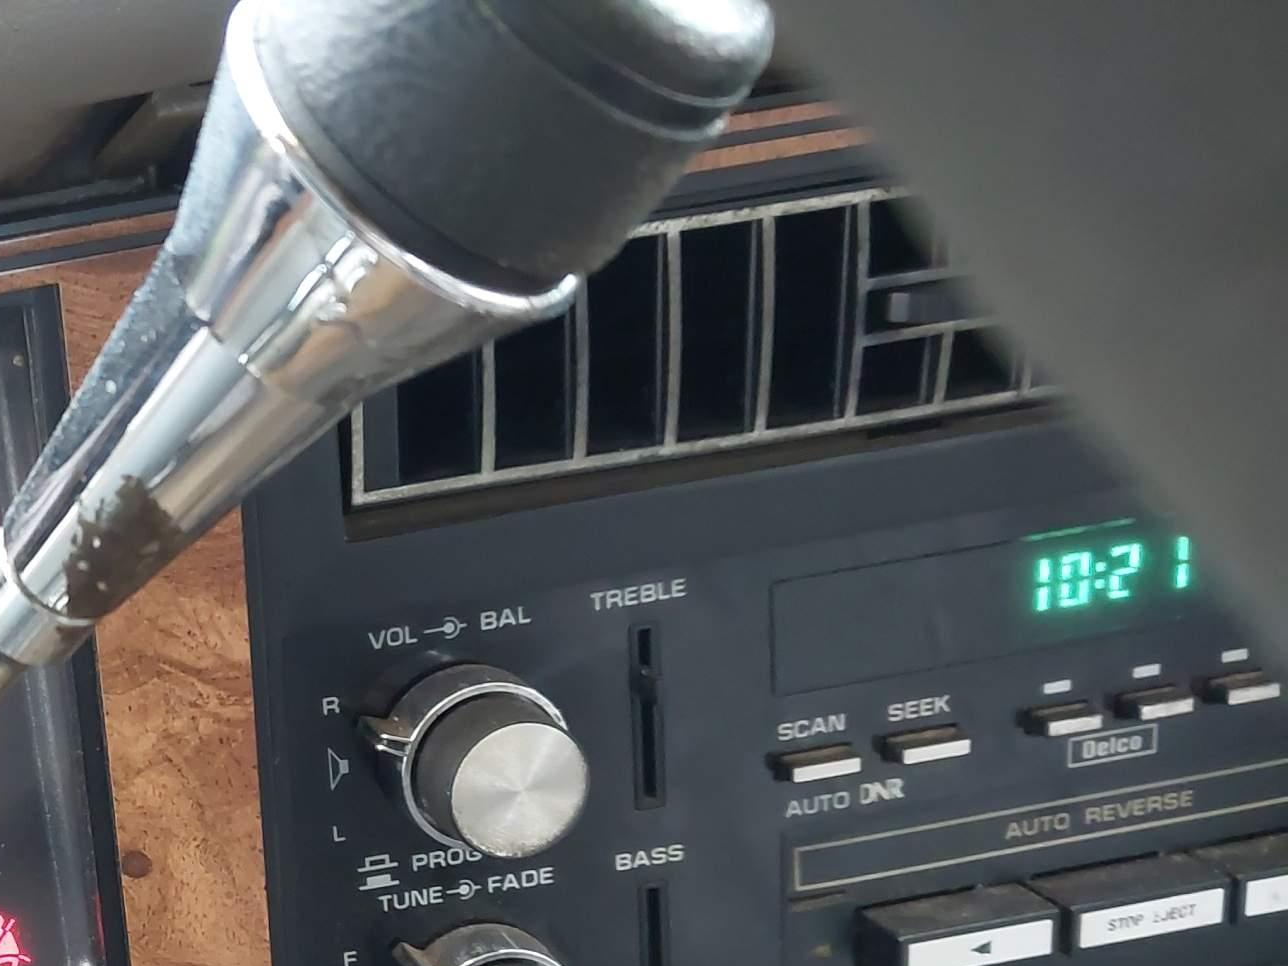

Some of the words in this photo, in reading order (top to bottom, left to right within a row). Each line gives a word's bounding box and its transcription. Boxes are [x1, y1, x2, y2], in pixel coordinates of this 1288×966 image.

[1034, 535, 1190, 612] 10:21
[591, 578, 688, 612] TREBLE
[368, 625, 418, 651] VOL
[480, 606, 532, 632] BAL
[321, 697, 340, 716] R
[888, 695, 951, 722] SEEK
[777, 712, 846, 742] SCAN
[1082, 735, 1143, 760] Delco
[785, 789, 850, 818] AUTO
[860, 778, 905, 805] DNR
[1006, 811, 1071, 841] AUTO
[1085, 790, 1194, 825] REVERSE
[332, 826, 346, 842] L
[615, 845, 684, 871] BASS
[378, 886, 443, 912] TUNE
[487, 867, 554, 893] FADE
[343, 951, 357, 966] F
